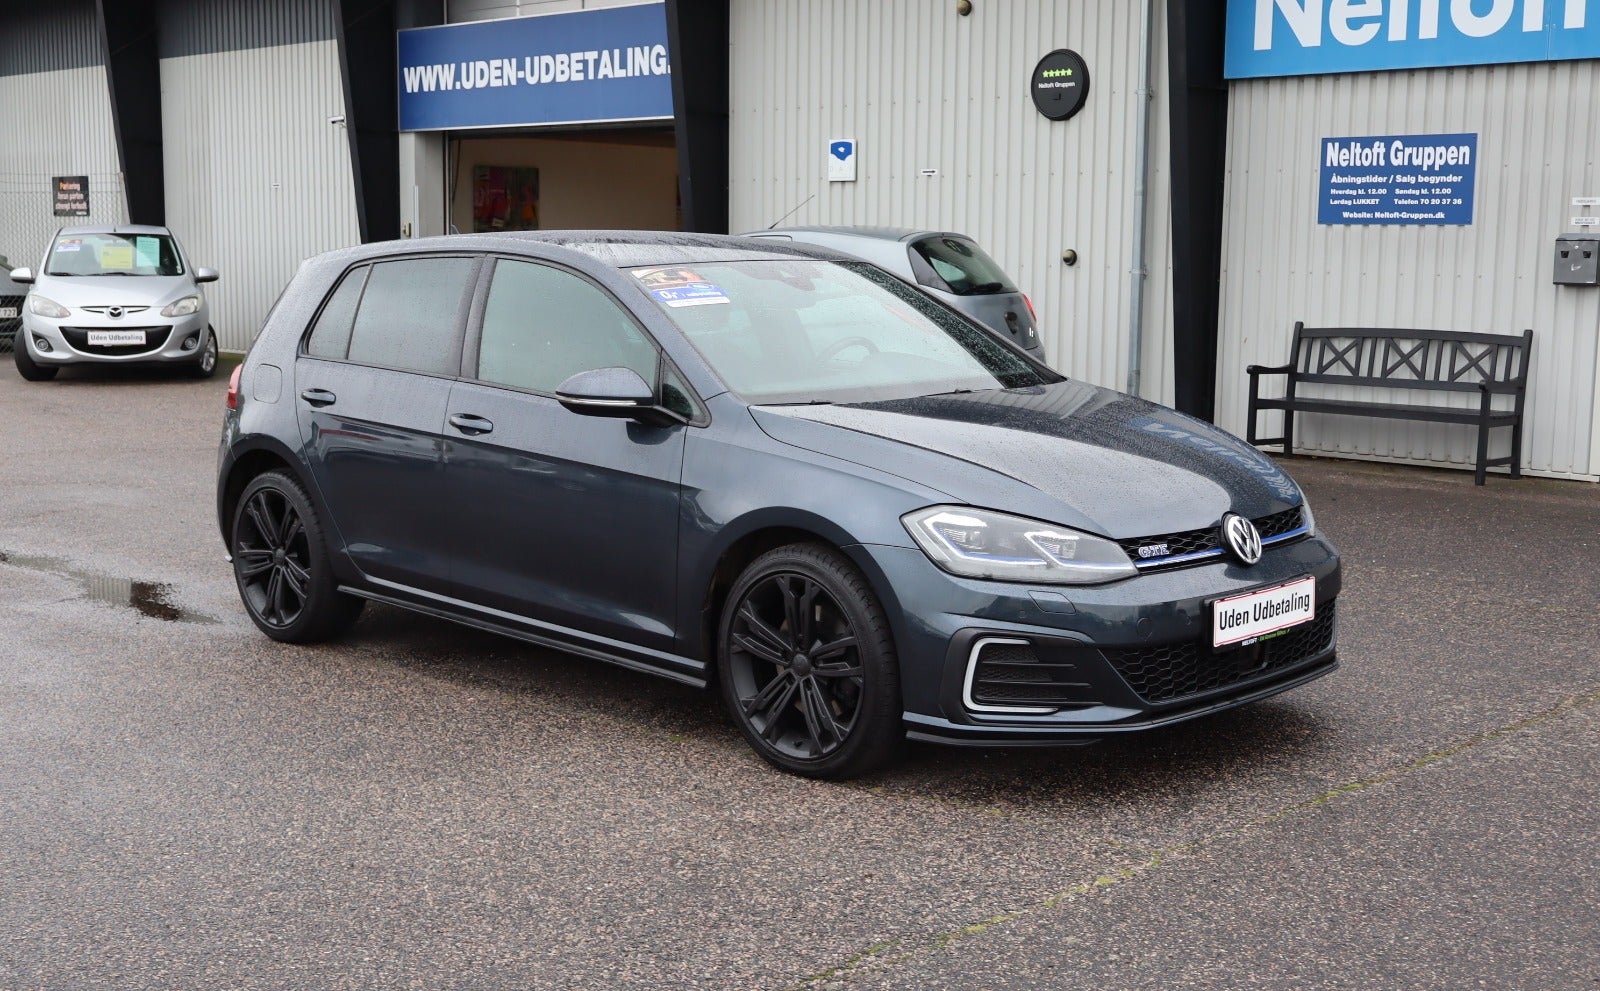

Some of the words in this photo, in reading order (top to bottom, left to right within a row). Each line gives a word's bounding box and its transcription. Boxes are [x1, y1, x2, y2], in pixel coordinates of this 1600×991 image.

[1326, 141, 1386, 167] Neltoft
[1390, 140, 1470, 171] Gruppen
[1331, 173, 1387, 185] Åbningstider
[1389, 174, 1394, 184] /
[1395, 174, 1416, 184] Salg
[1418, 174, 1463, 184] begynder
[1342, 211, 1374, 219] Website:
[1375, 211, 1446, 219] Neltoft-Gruppen.dk
[1138, 543, 1170, 558] GTE
[1219, 609, 1249, 630] Uden
[1253, 592, 1311, 622] Udbetaling
